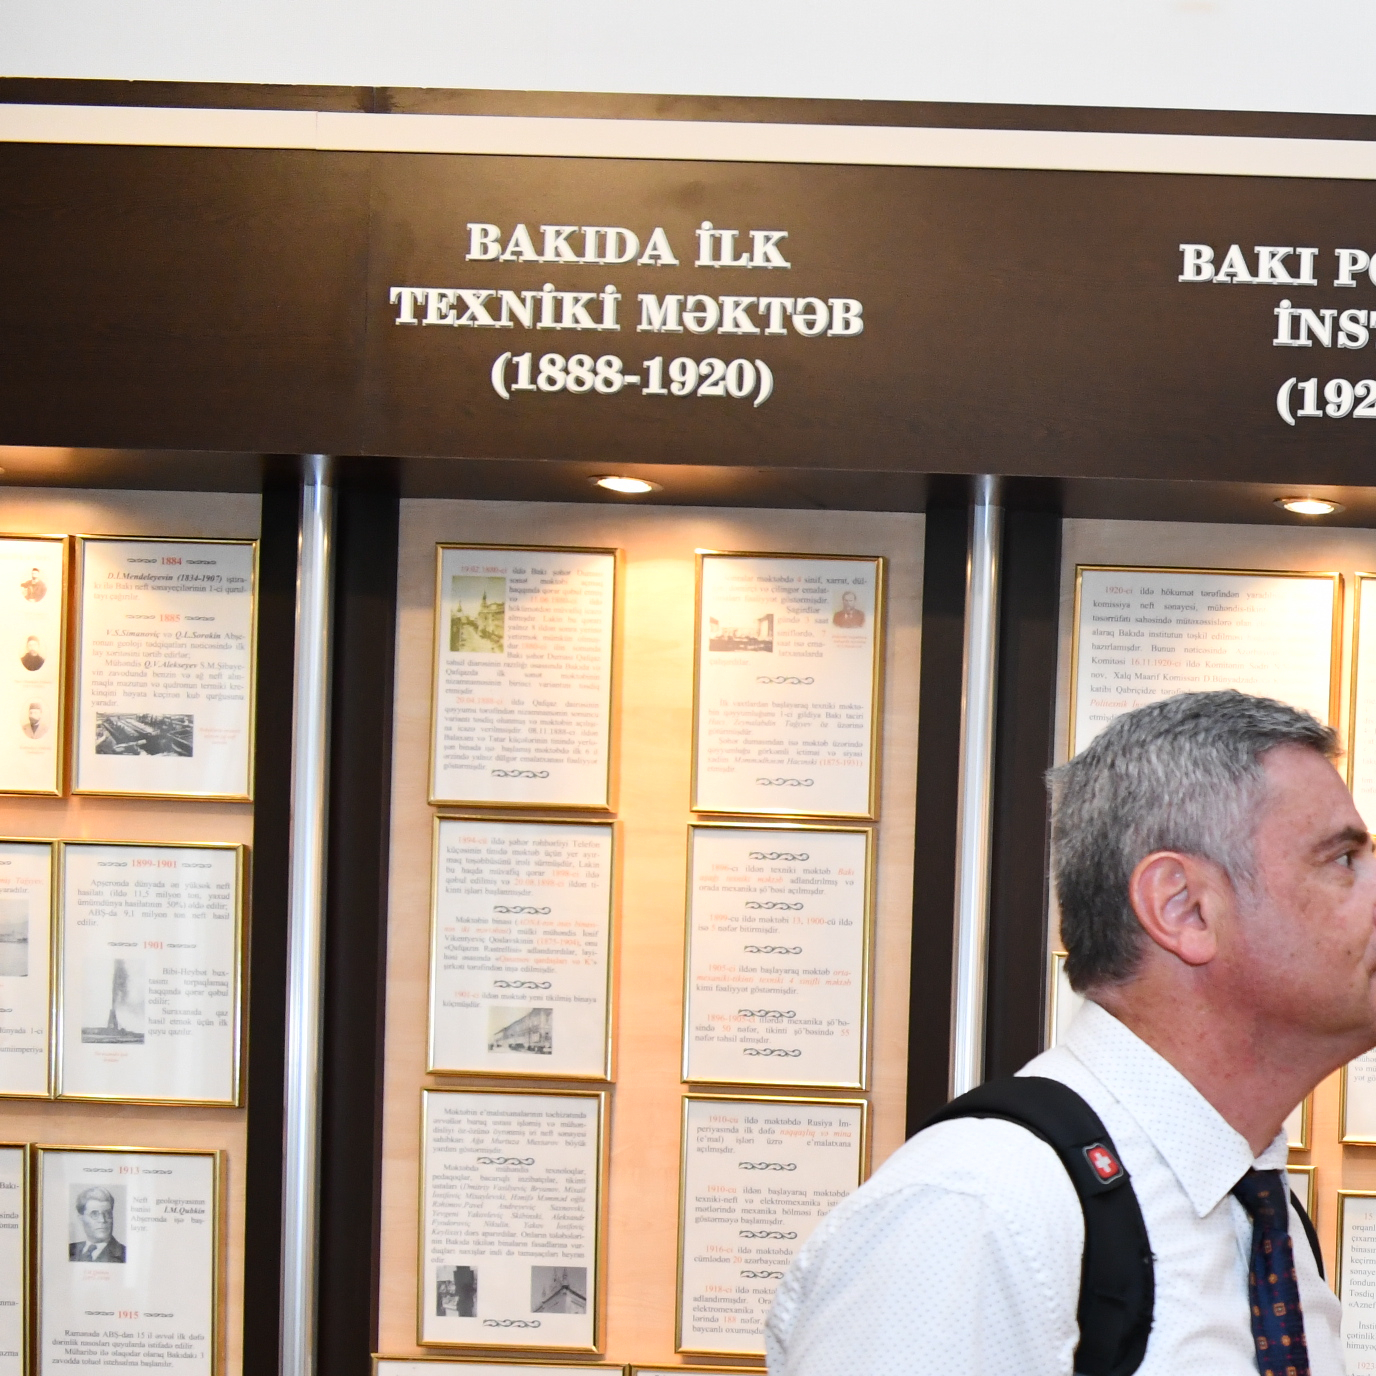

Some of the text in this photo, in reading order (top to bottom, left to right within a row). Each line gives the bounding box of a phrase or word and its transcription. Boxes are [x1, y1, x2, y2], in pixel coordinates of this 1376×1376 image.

[465, 222, 791, 270] BAKIDA İLK
[1178, 243, 1319, 287] BAKI
[389, 283, 864, 337] TEXNİKİ MƏKTƏB
[491, 351, 774, 408] (1888-1920)
[161, 557, 182, 565] 1884
[160, 614, 181, 623] 1885
[132, 859, 177, 868] 1899-1901
[143, 941, 163, 950] 1901
[119, 1166, 140, 1174] 1913
[118, 1310, 139, 1320] 1915
